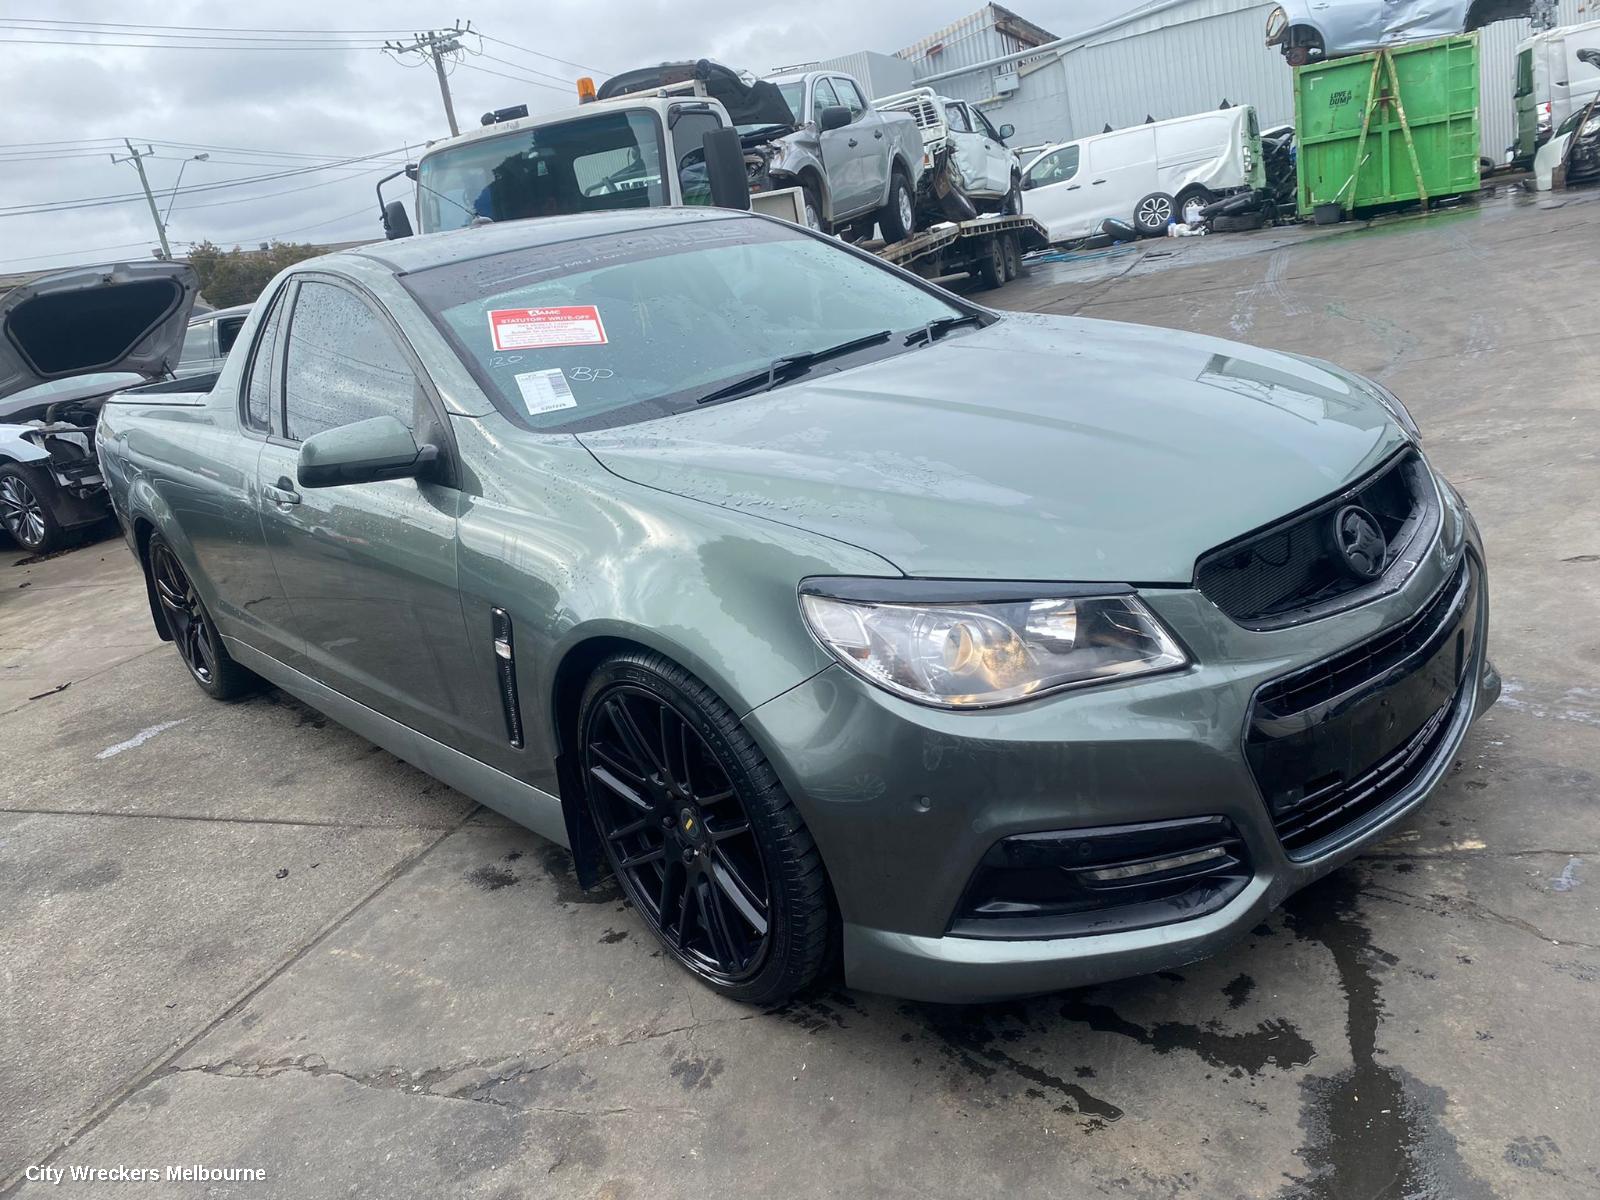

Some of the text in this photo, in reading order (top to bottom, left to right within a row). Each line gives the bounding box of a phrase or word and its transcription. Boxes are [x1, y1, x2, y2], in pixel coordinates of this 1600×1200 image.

[1329, 96, 1352, 105] DUMP
[501, 316, 547, 324] STATUTORY
[569, 366, 614, 383] BP
